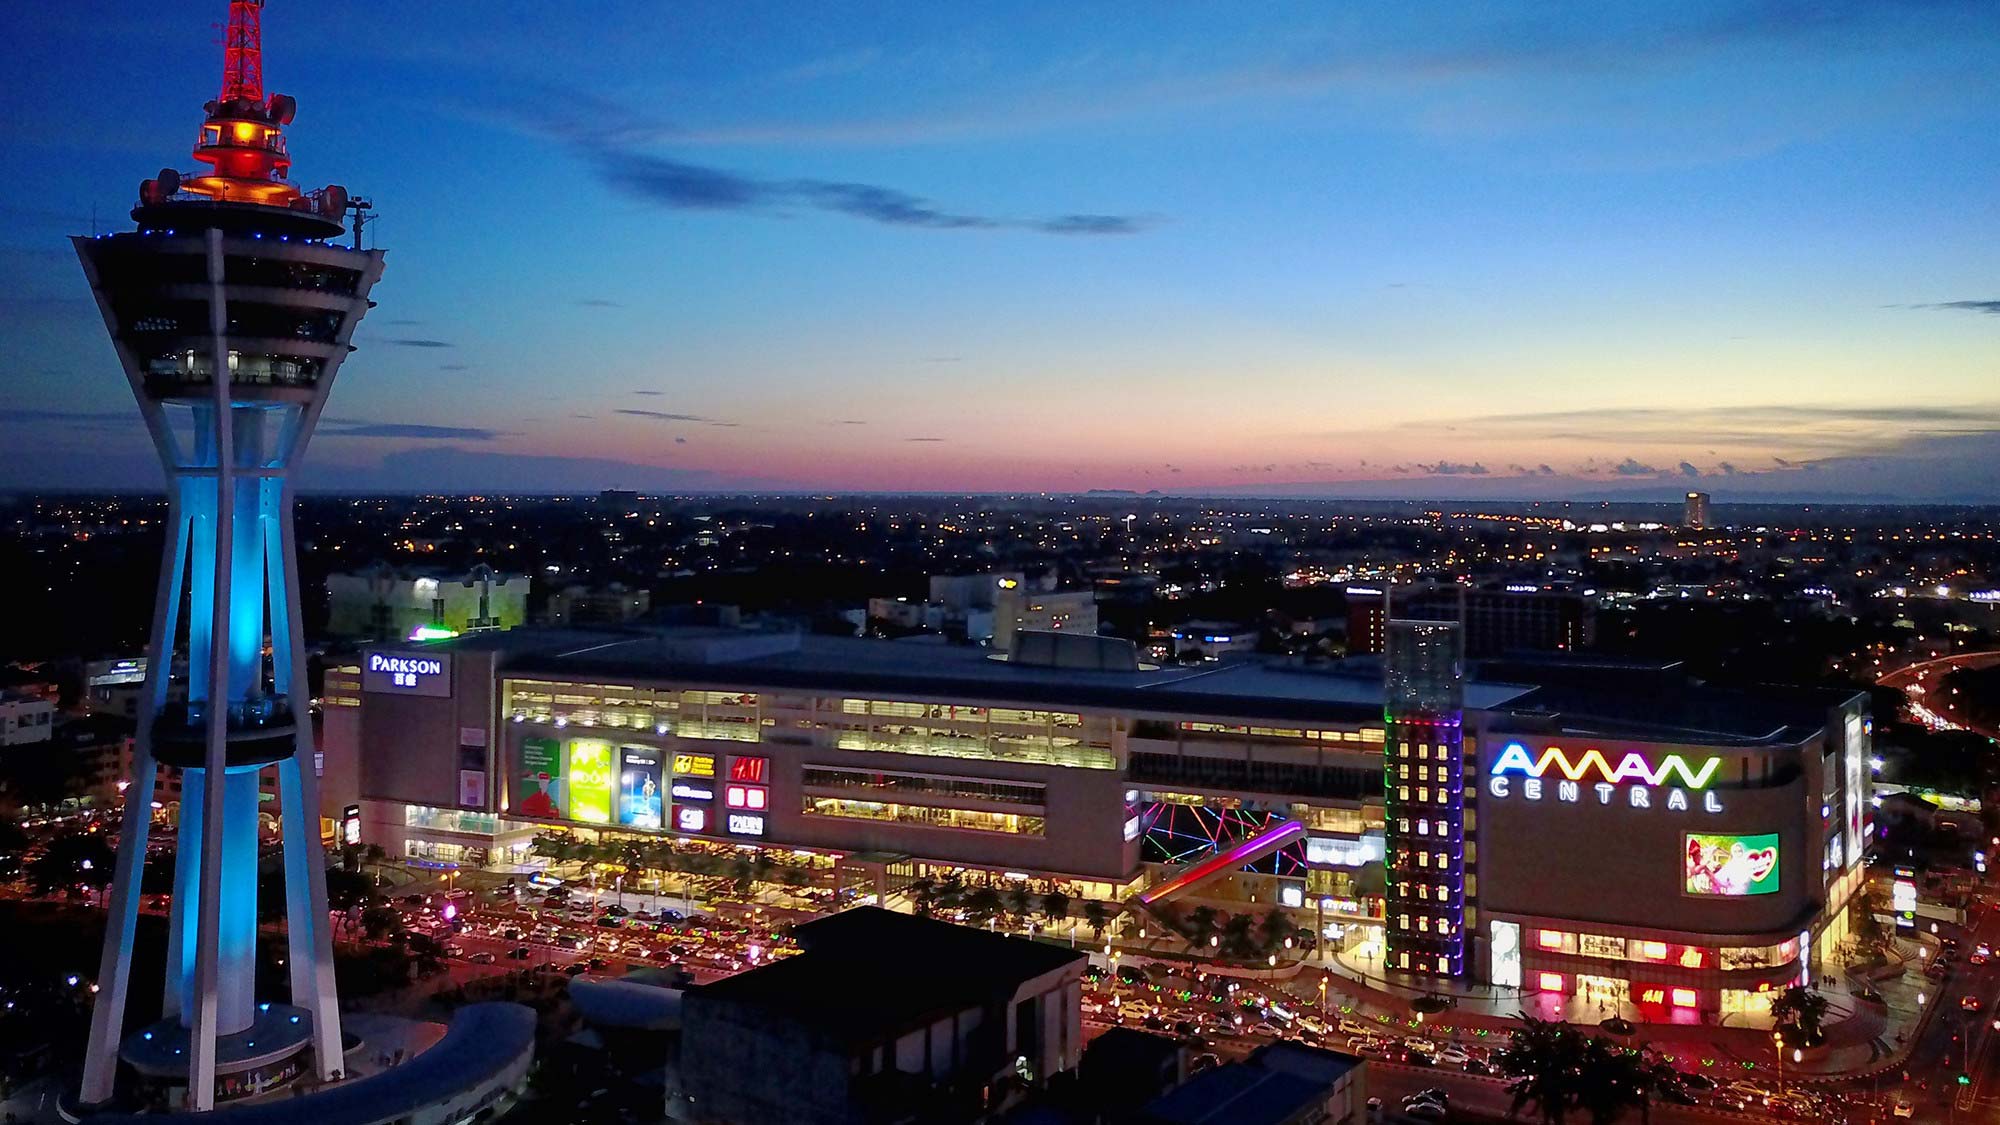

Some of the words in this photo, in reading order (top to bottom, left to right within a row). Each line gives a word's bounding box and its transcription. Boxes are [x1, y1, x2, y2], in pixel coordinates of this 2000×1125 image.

[371, 654, 441, 674] PARKSON
[731, 757, 764, 782] H&M
[1491, 743, 1722, 788] AMAN
[1490, 777, 1722, 812] CENTRAL
